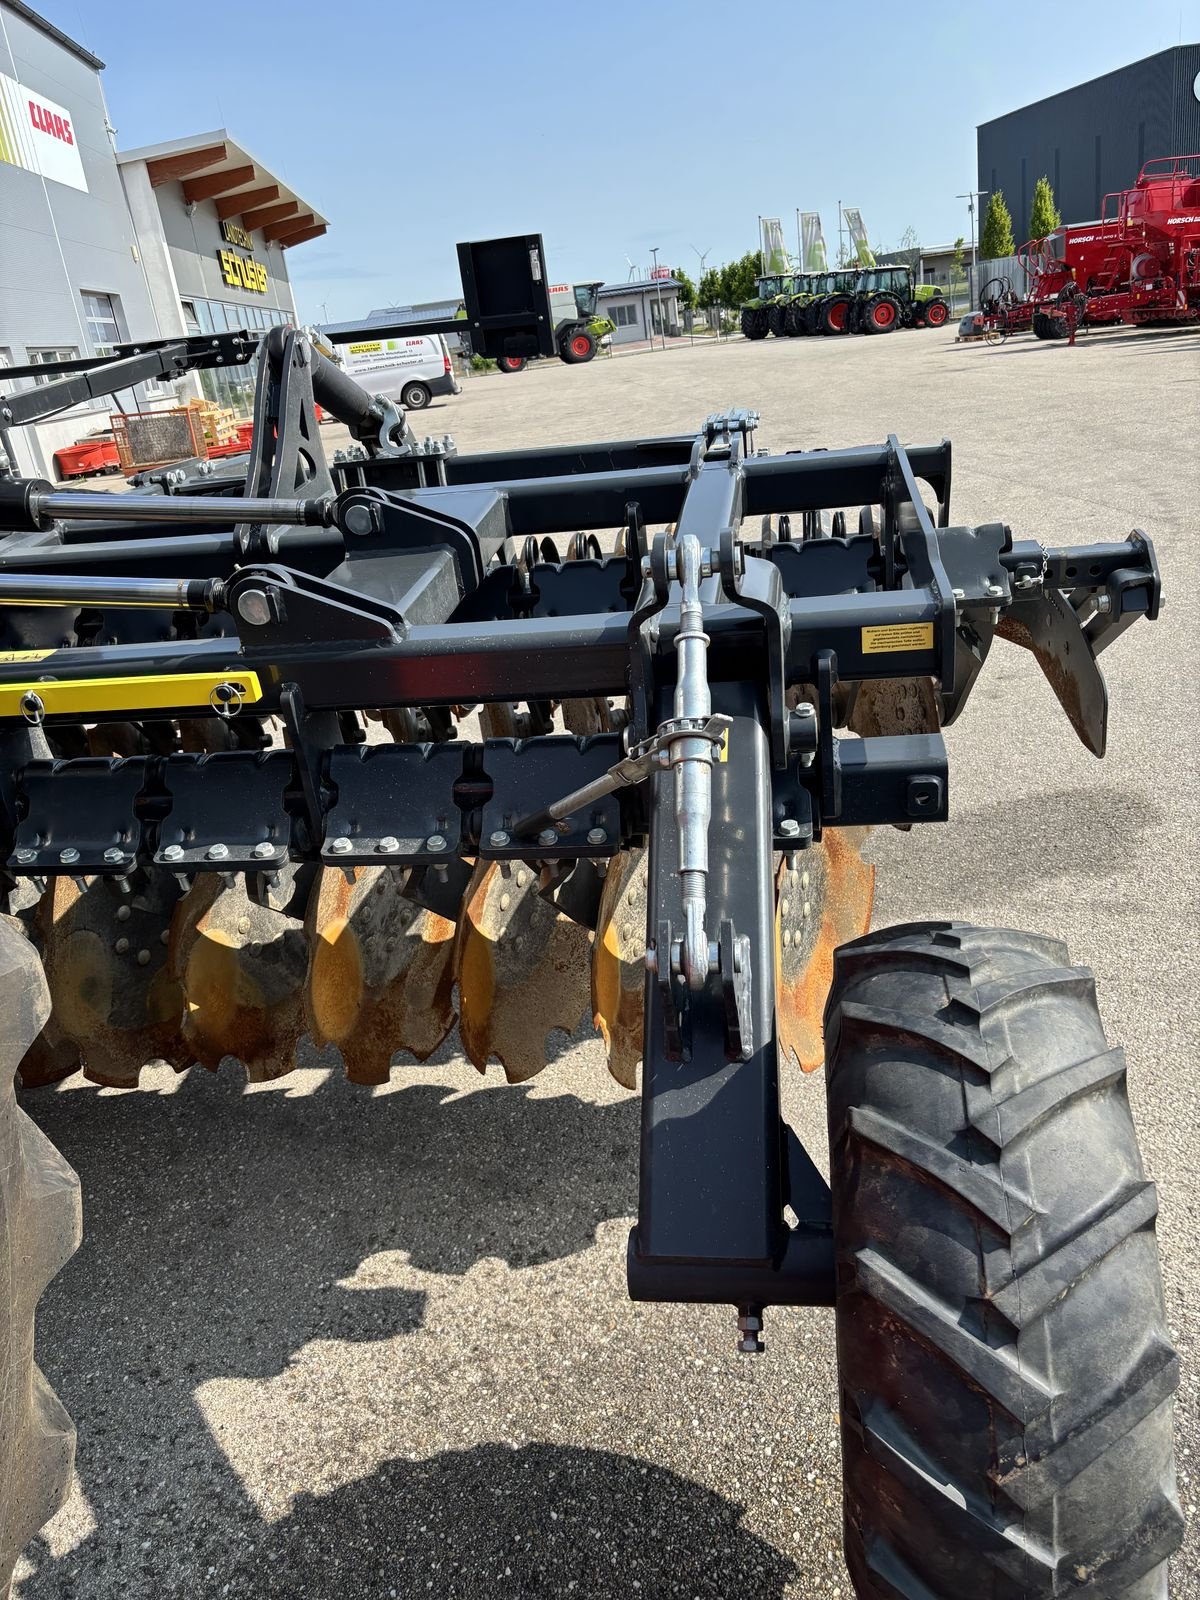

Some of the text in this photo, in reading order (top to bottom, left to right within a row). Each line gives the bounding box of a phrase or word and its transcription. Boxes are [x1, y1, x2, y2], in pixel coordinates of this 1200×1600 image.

[28, 100, 74, 146] CLAAS
[1167, 216, 1194, 224] HORSCH
[1068, 235, 1094, 244] HORSCH
